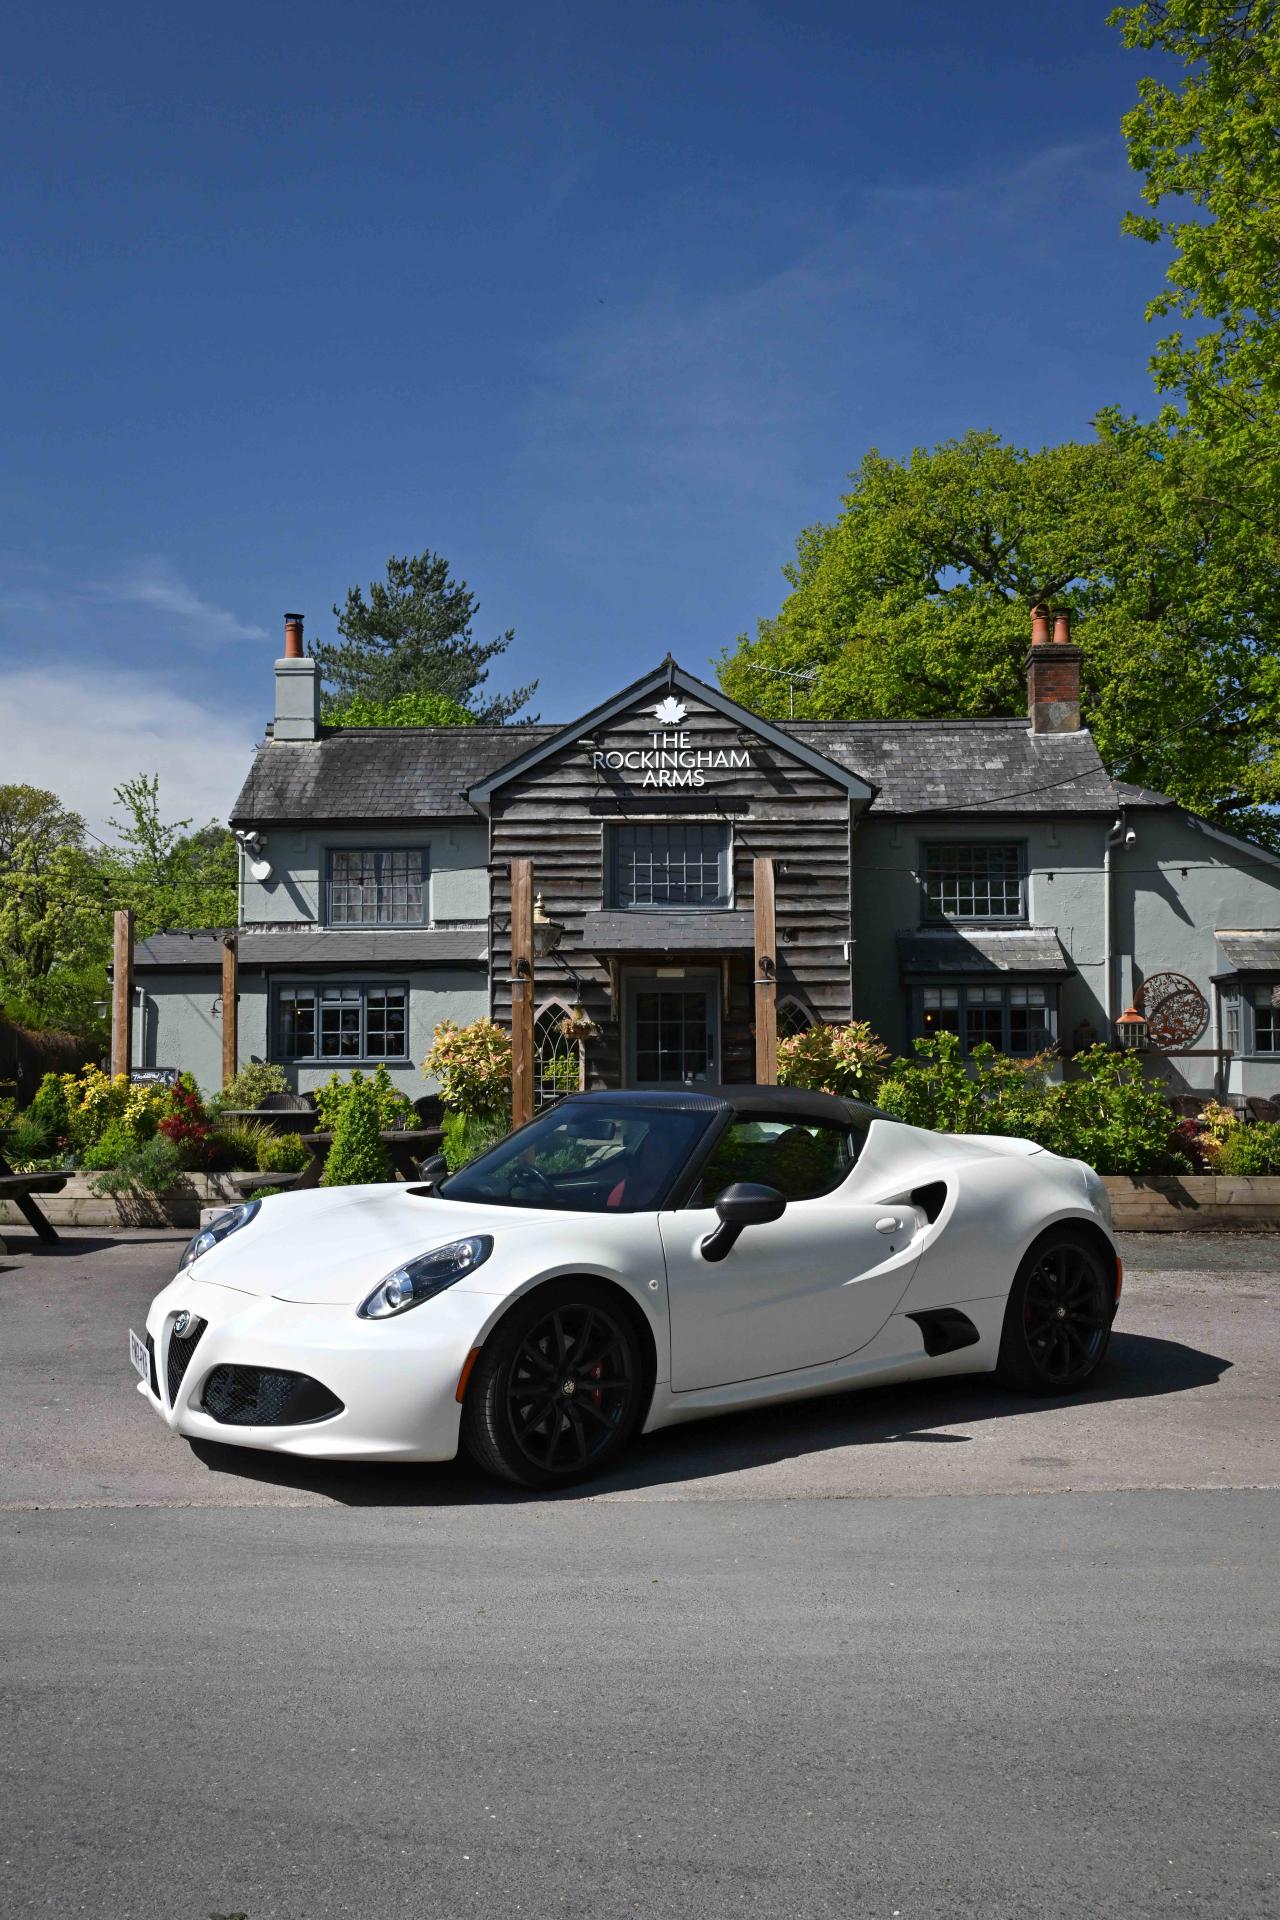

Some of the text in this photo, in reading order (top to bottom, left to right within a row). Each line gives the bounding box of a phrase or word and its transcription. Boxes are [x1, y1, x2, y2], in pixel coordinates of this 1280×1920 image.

[649, 731, 691, 749] THE
[592, 750, 750, 769] ROCKINGHAM
[642, 769, 705, 788] ARMS
